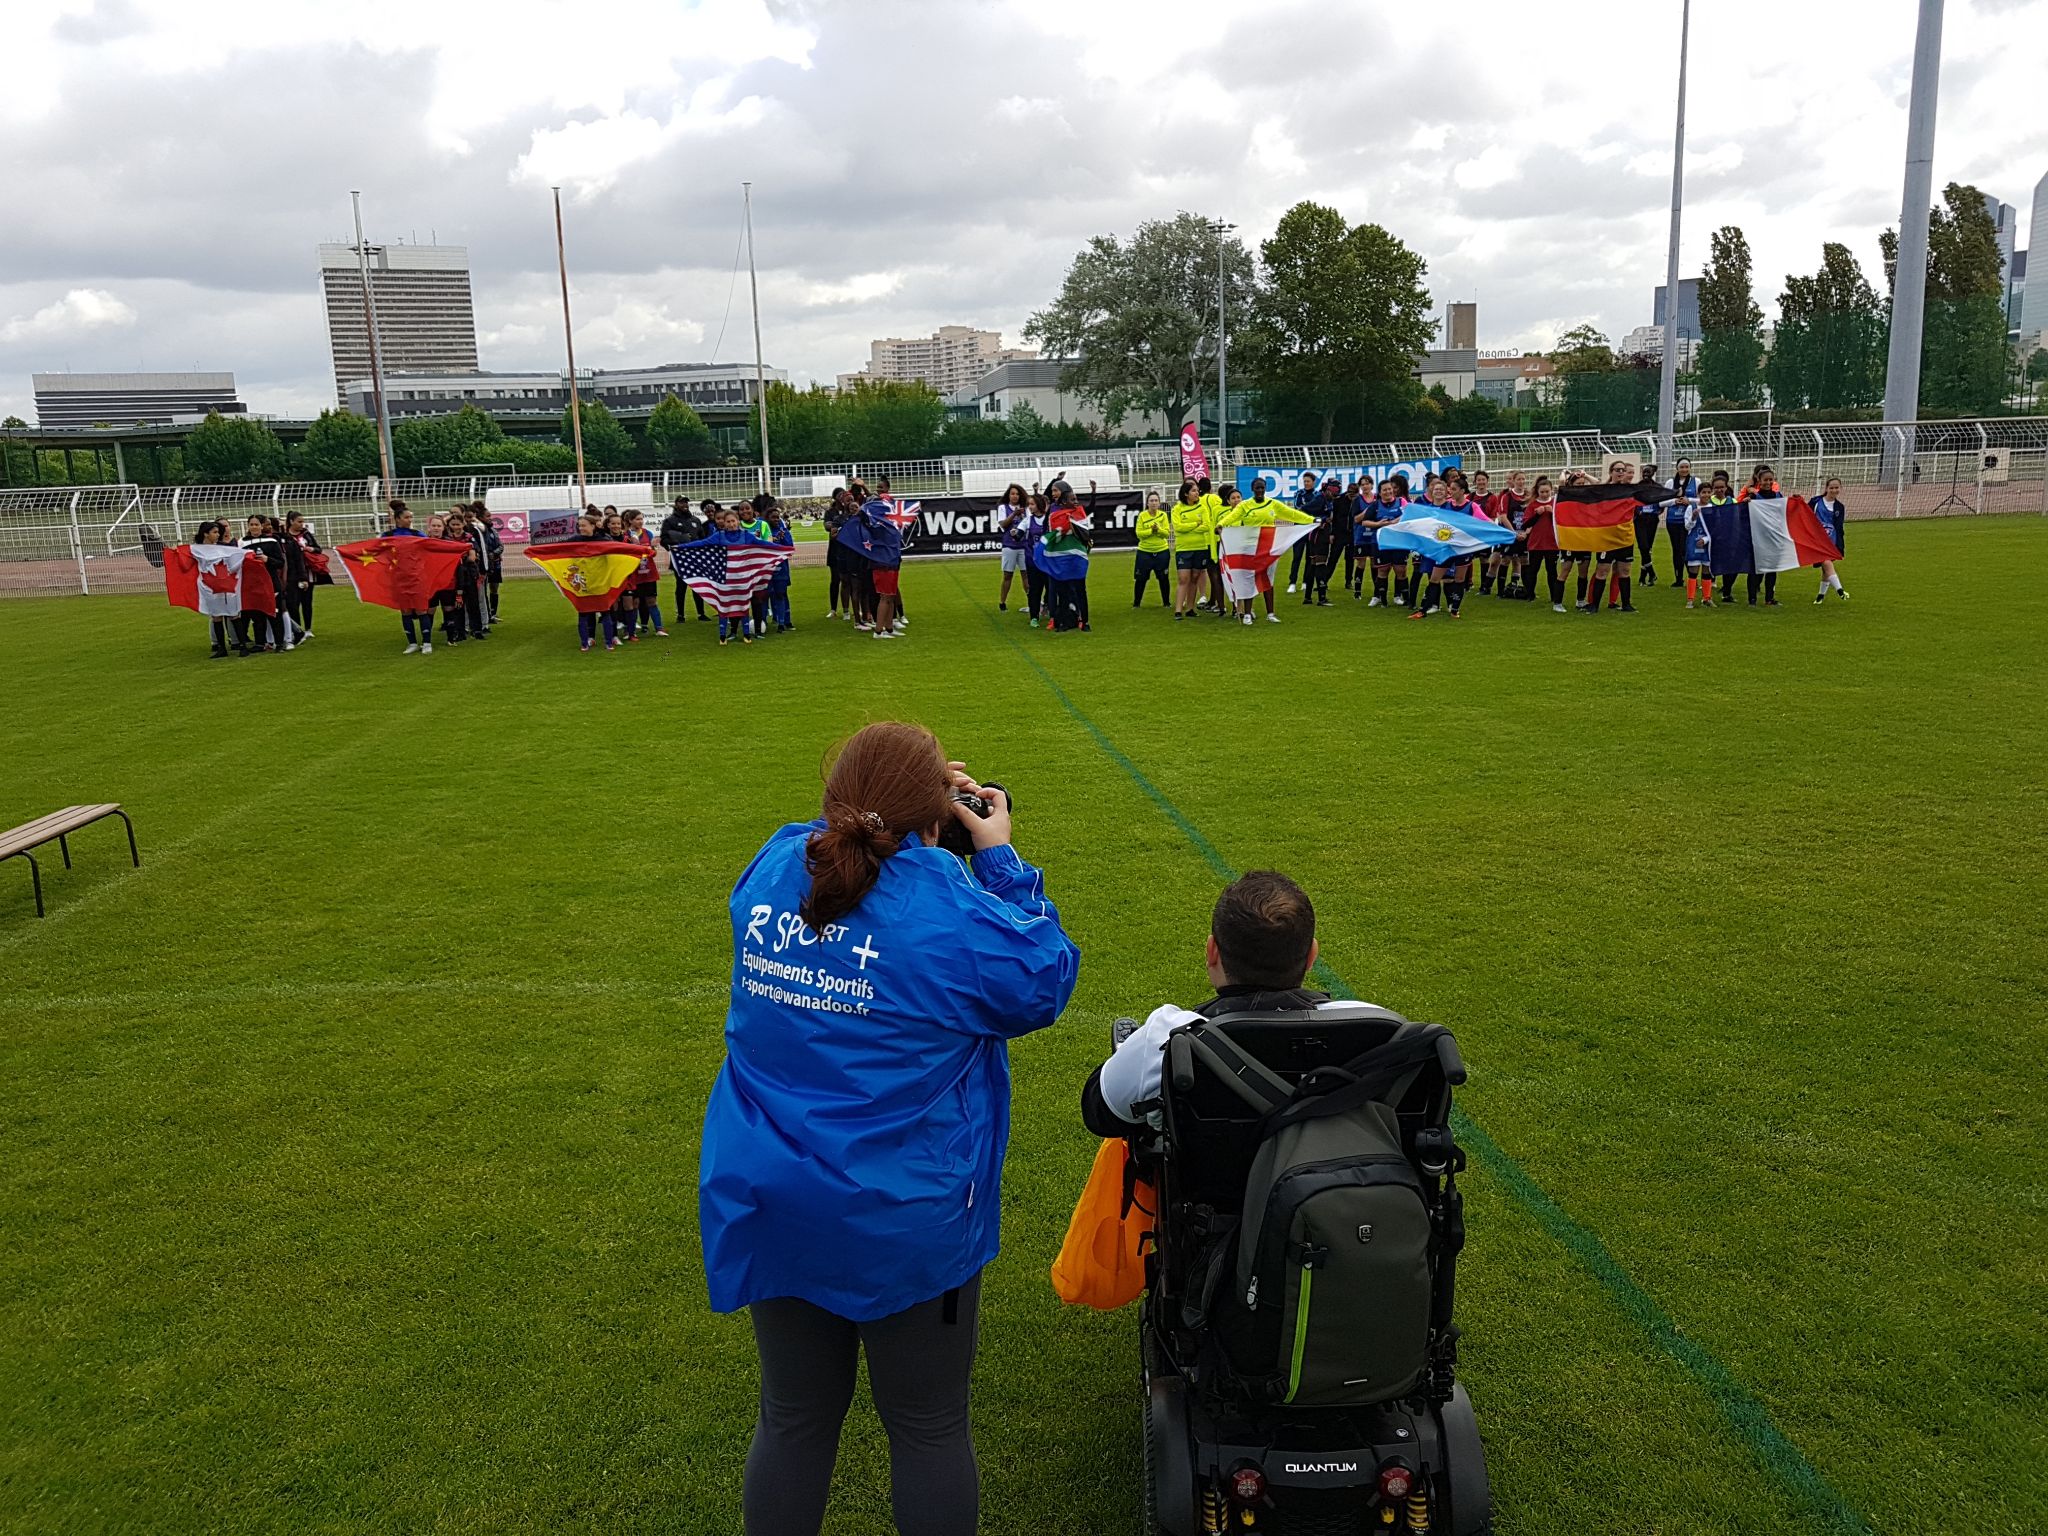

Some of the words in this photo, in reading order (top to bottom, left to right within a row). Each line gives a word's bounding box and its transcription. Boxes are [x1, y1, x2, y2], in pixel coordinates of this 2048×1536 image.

[1105, 504, 1140, 529] .fr
[942, 541, 983, 552] #upper
[744, 904, 773, 946] R
[772, 911, 850, 953] SPORT
[742, 946, 814, 985] Equipements
[815, 968, 874, 1000] Sportifs
[741, 975, 870, 1017] r-sport@wanadoo.fr
[1285, 1462, 1357, 1473] QUANTUM
